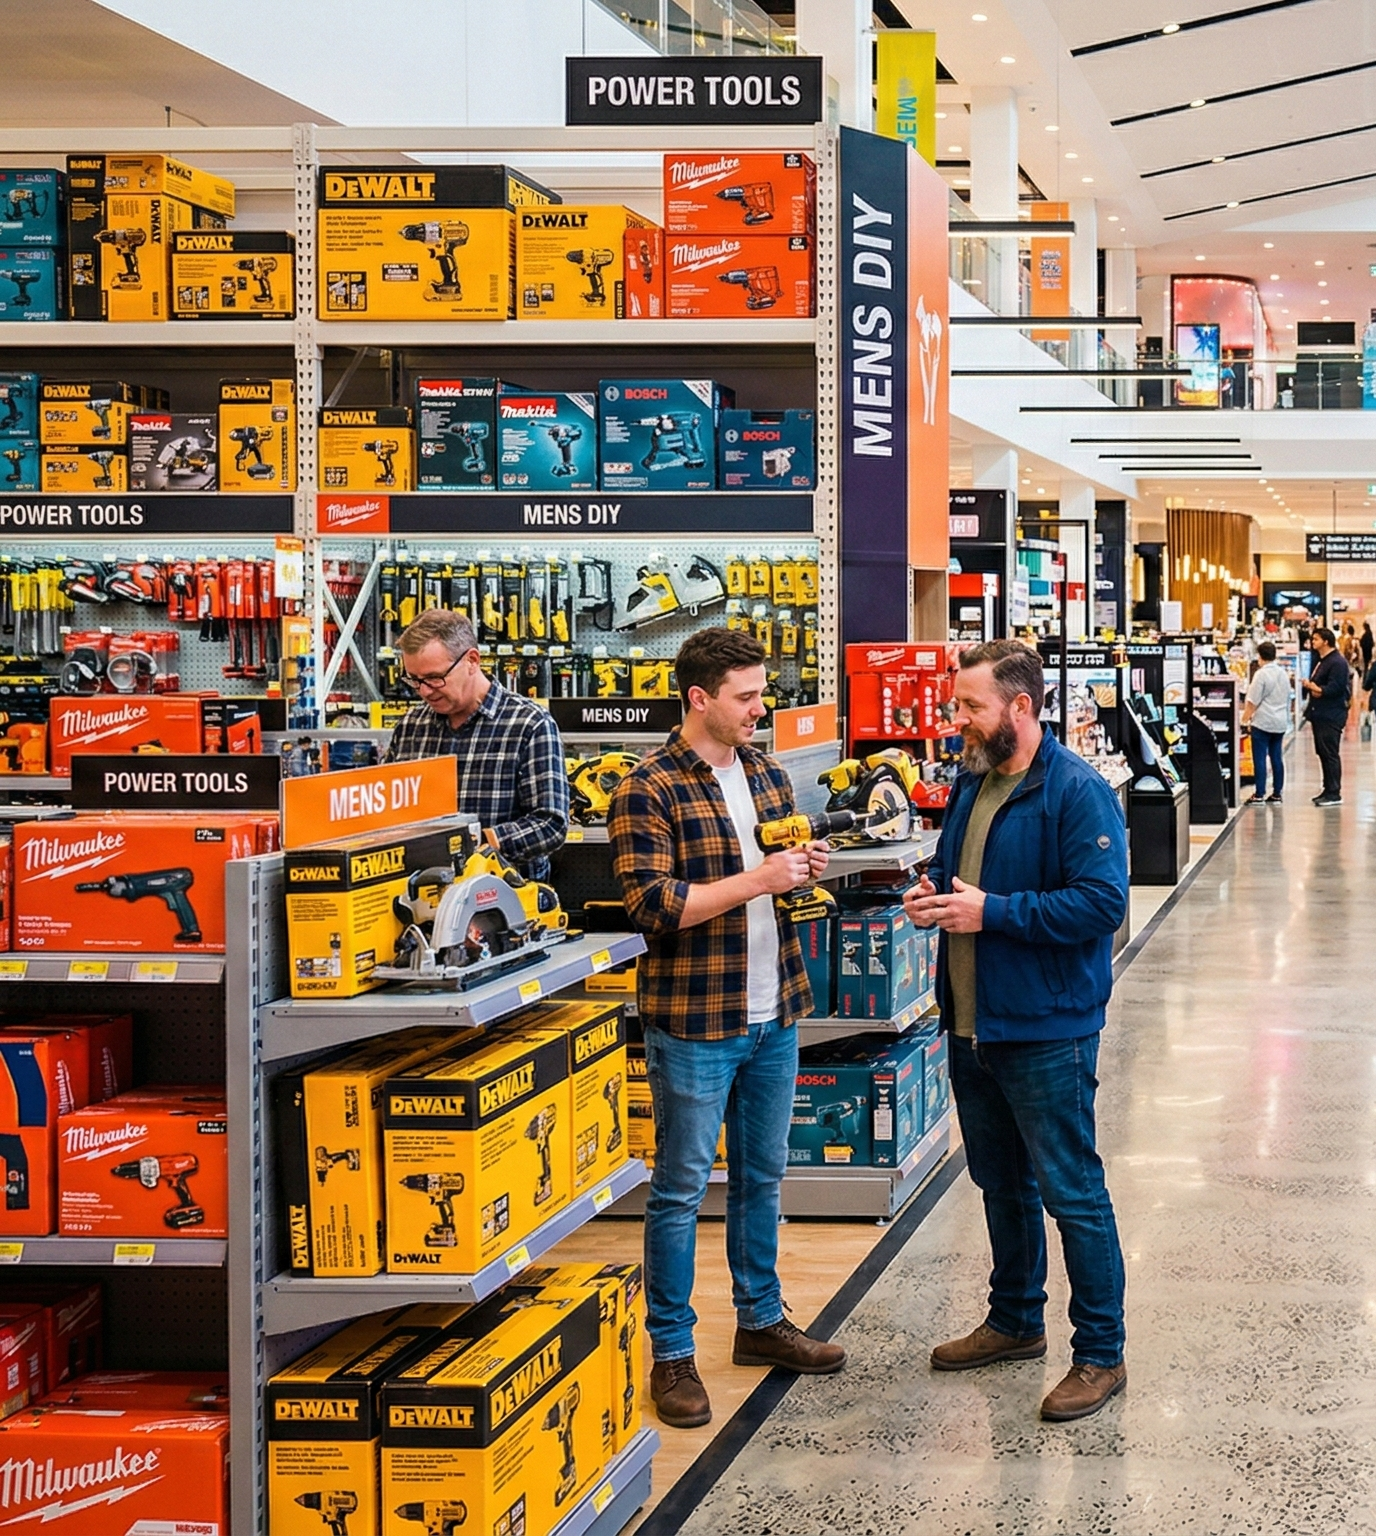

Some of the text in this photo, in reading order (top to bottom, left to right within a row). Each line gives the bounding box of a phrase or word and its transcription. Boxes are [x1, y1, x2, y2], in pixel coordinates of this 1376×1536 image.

[588, 75, 801, 106] POWER TOOLS
[325, 173, 435, 201] DEWALT
[522, 213, 588, 229] DEWALT
[852, 193, 894, 457] MENS DIY
[624, 388, 668, 400] BOSCH
[0, 504, 144, 526] POWER TOOLS
[523, 504, 622, 526] MENS DIY
[58, 704, 150, 737] Milwaukee
[581, 708, 650, 723] MENS DIY
[104, 772, 249, 793] POWER TOOLS
[330, 775, 422, 822] MENS DIY
[20, 831, 127, 871] Milwaukee
[289, 866, 341, 882] DEWALT
[350, 846, 406, 883] DEWALT
[575, 1016, 619, 1065] DEWALT
[479, 1061, 535, 1118] DEWALT
[795, 1074, 837, 1086] BOSCH
[390, 1095, 466, 1116] DEWALT
[62, 1122, 149, 1154] Milwaukee
[394, 1253, 442, 1264] DEWALT
[491, 1335, 563, 1431] DEWALT
[275, 1399, 359, 1422] DEWALT
[389, 1405, 475, 1429] DEWALT
[0, 1446, 161, 1507] Milwaukee
